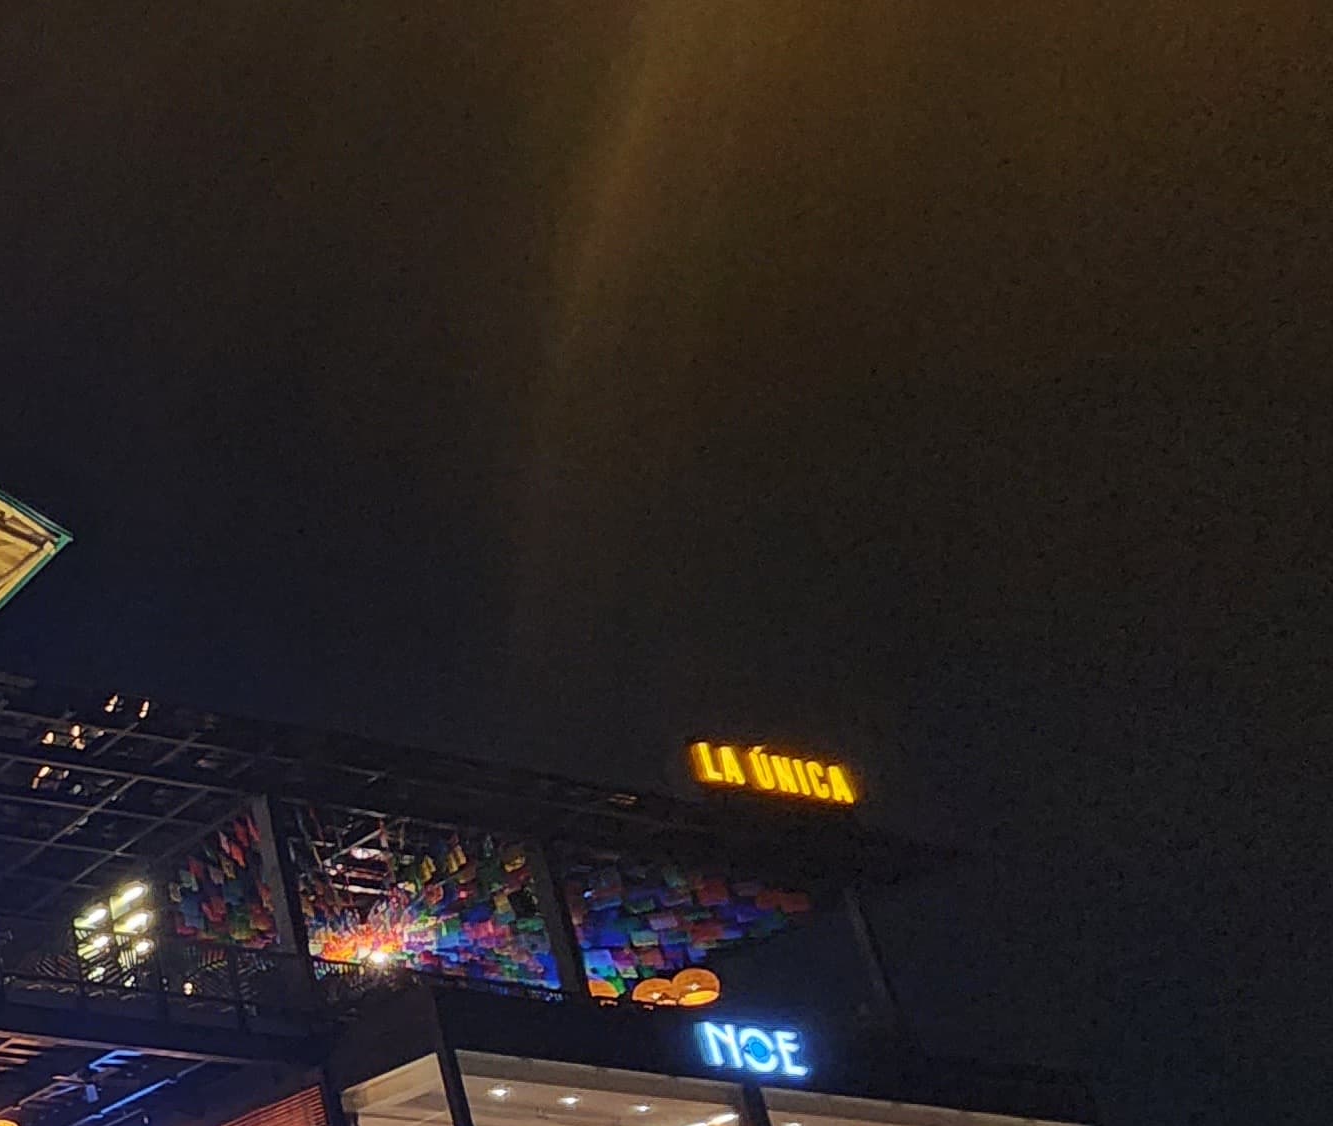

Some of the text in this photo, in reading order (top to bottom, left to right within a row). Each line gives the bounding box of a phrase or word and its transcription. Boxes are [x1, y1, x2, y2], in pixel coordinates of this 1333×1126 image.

[691, 741, 857, 805] LA ÚNICA
[698, 1021, 809, 1077] NOE
